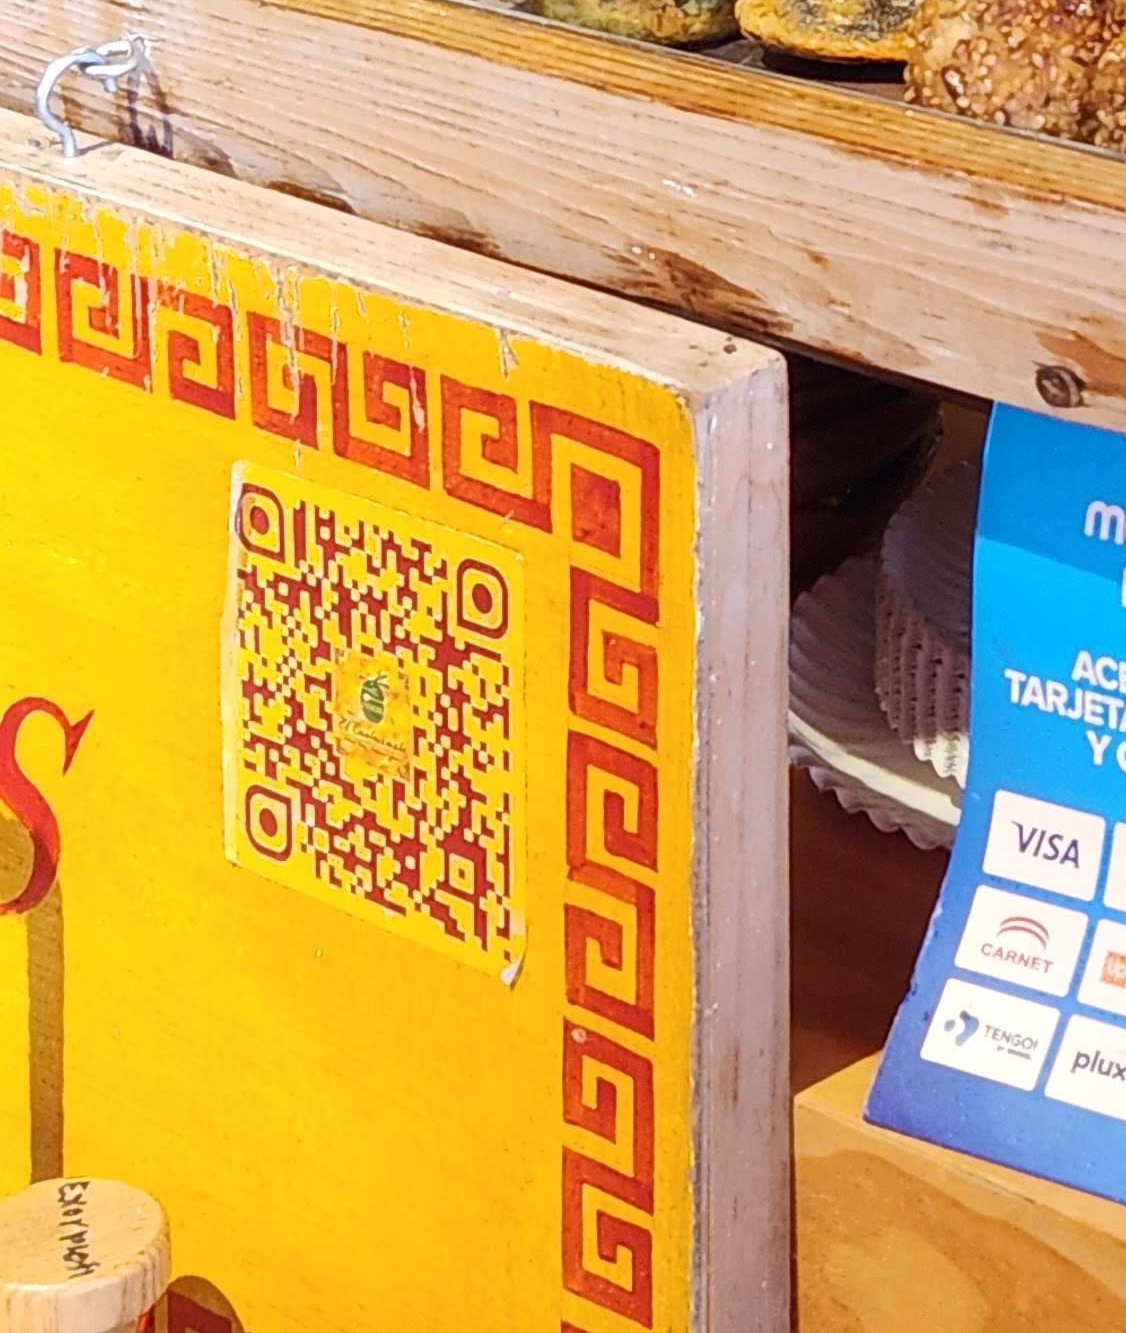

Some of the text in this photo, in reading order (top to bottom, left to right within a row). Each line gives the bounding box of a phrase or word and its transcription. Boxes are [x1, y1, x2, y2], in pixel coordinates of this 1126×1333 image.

[1086, 730, 1112, 766] Y
[1011, 820, 1080, 869] VISA
[980, 942, 1054, 975] CARNET
